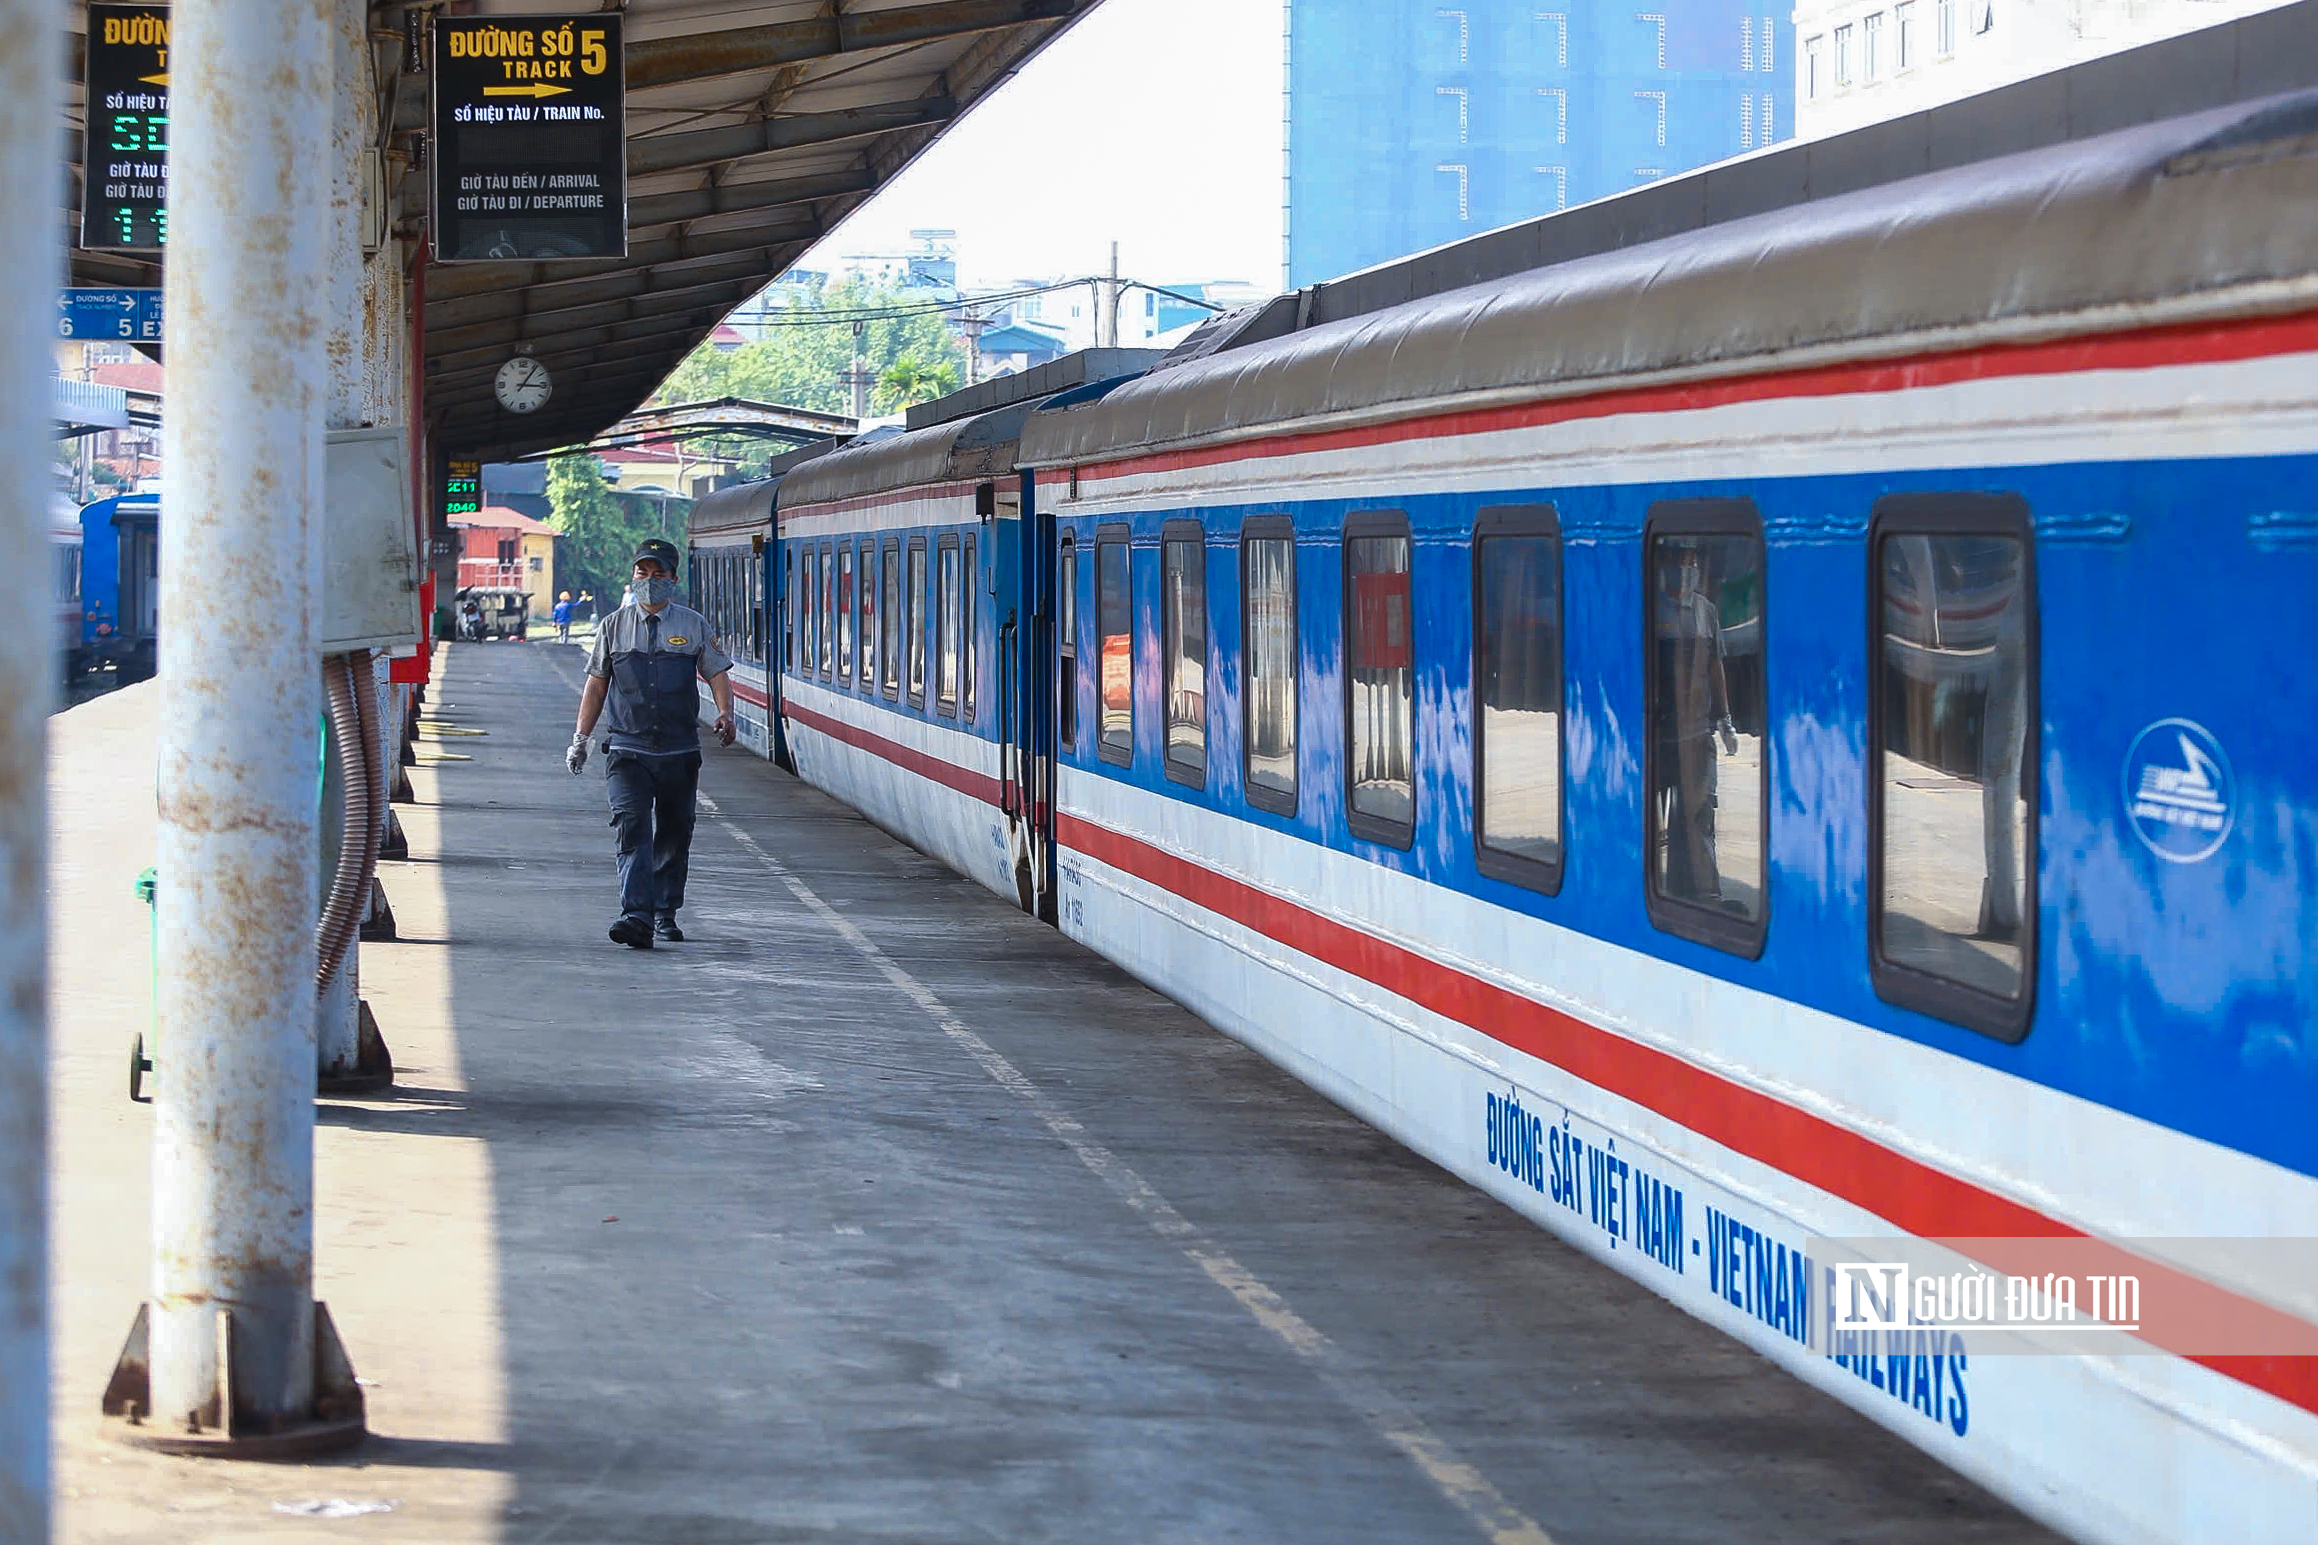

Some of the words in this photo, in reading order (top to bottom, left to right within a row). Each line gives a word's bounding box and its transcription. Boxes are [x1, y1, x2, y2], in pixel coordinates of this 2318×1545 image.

[105, 12, 170, 45] ĐƯỜN
[450, 25, 534, 58] ĐƯỜNG
[541, 21, 574, 56] SỐ
[581, 30, 607, 75] 5
[503, 60, 572, 79] TRACK
[106, 90, 124, 110] SỐ
[126, 93, 156, 112] HIỆU
[454, 103, 472, 122] SỐ
[475, 105, 504, 124] HIỆU
[506, 104, 531, 121] TÀU
[543, 107, 581, 120] TRAIN
[584, 106, 605, 119] No.
[109, 161, 132, 178] GIỜ
[134, 162, 158, 178] TÀU
[461, 173, 482, 190] GIỜ
[485, 173, 509, 189] TÀU
[512, 171, 538, 189] ĐẾN
[549, 174, 600, 188] ARRIVAL
[106, 182, 128, 198] GIỜ
[129, 183, 153, 199] TÀU
[457, 194, 479, 211] GIỜ
[482, 194, 506, 210] TÀU
[509, 196, 522, 210] ĐI
[533, 194, 604, 209] DEPARTURE
[59, 317, 74, 336] 6
[118, 318, 133, 337] 5
[1487, 1085, 1544, 1193] ĐƯỜNG
[1550, 1108, 1582, 1215] SẮT
[1588, 1138, 1629, 1250] VIỆT
[1636, 1168, 1684, 1275] NAM
[1706, 1205, 1815, 1350] VIETNAM
